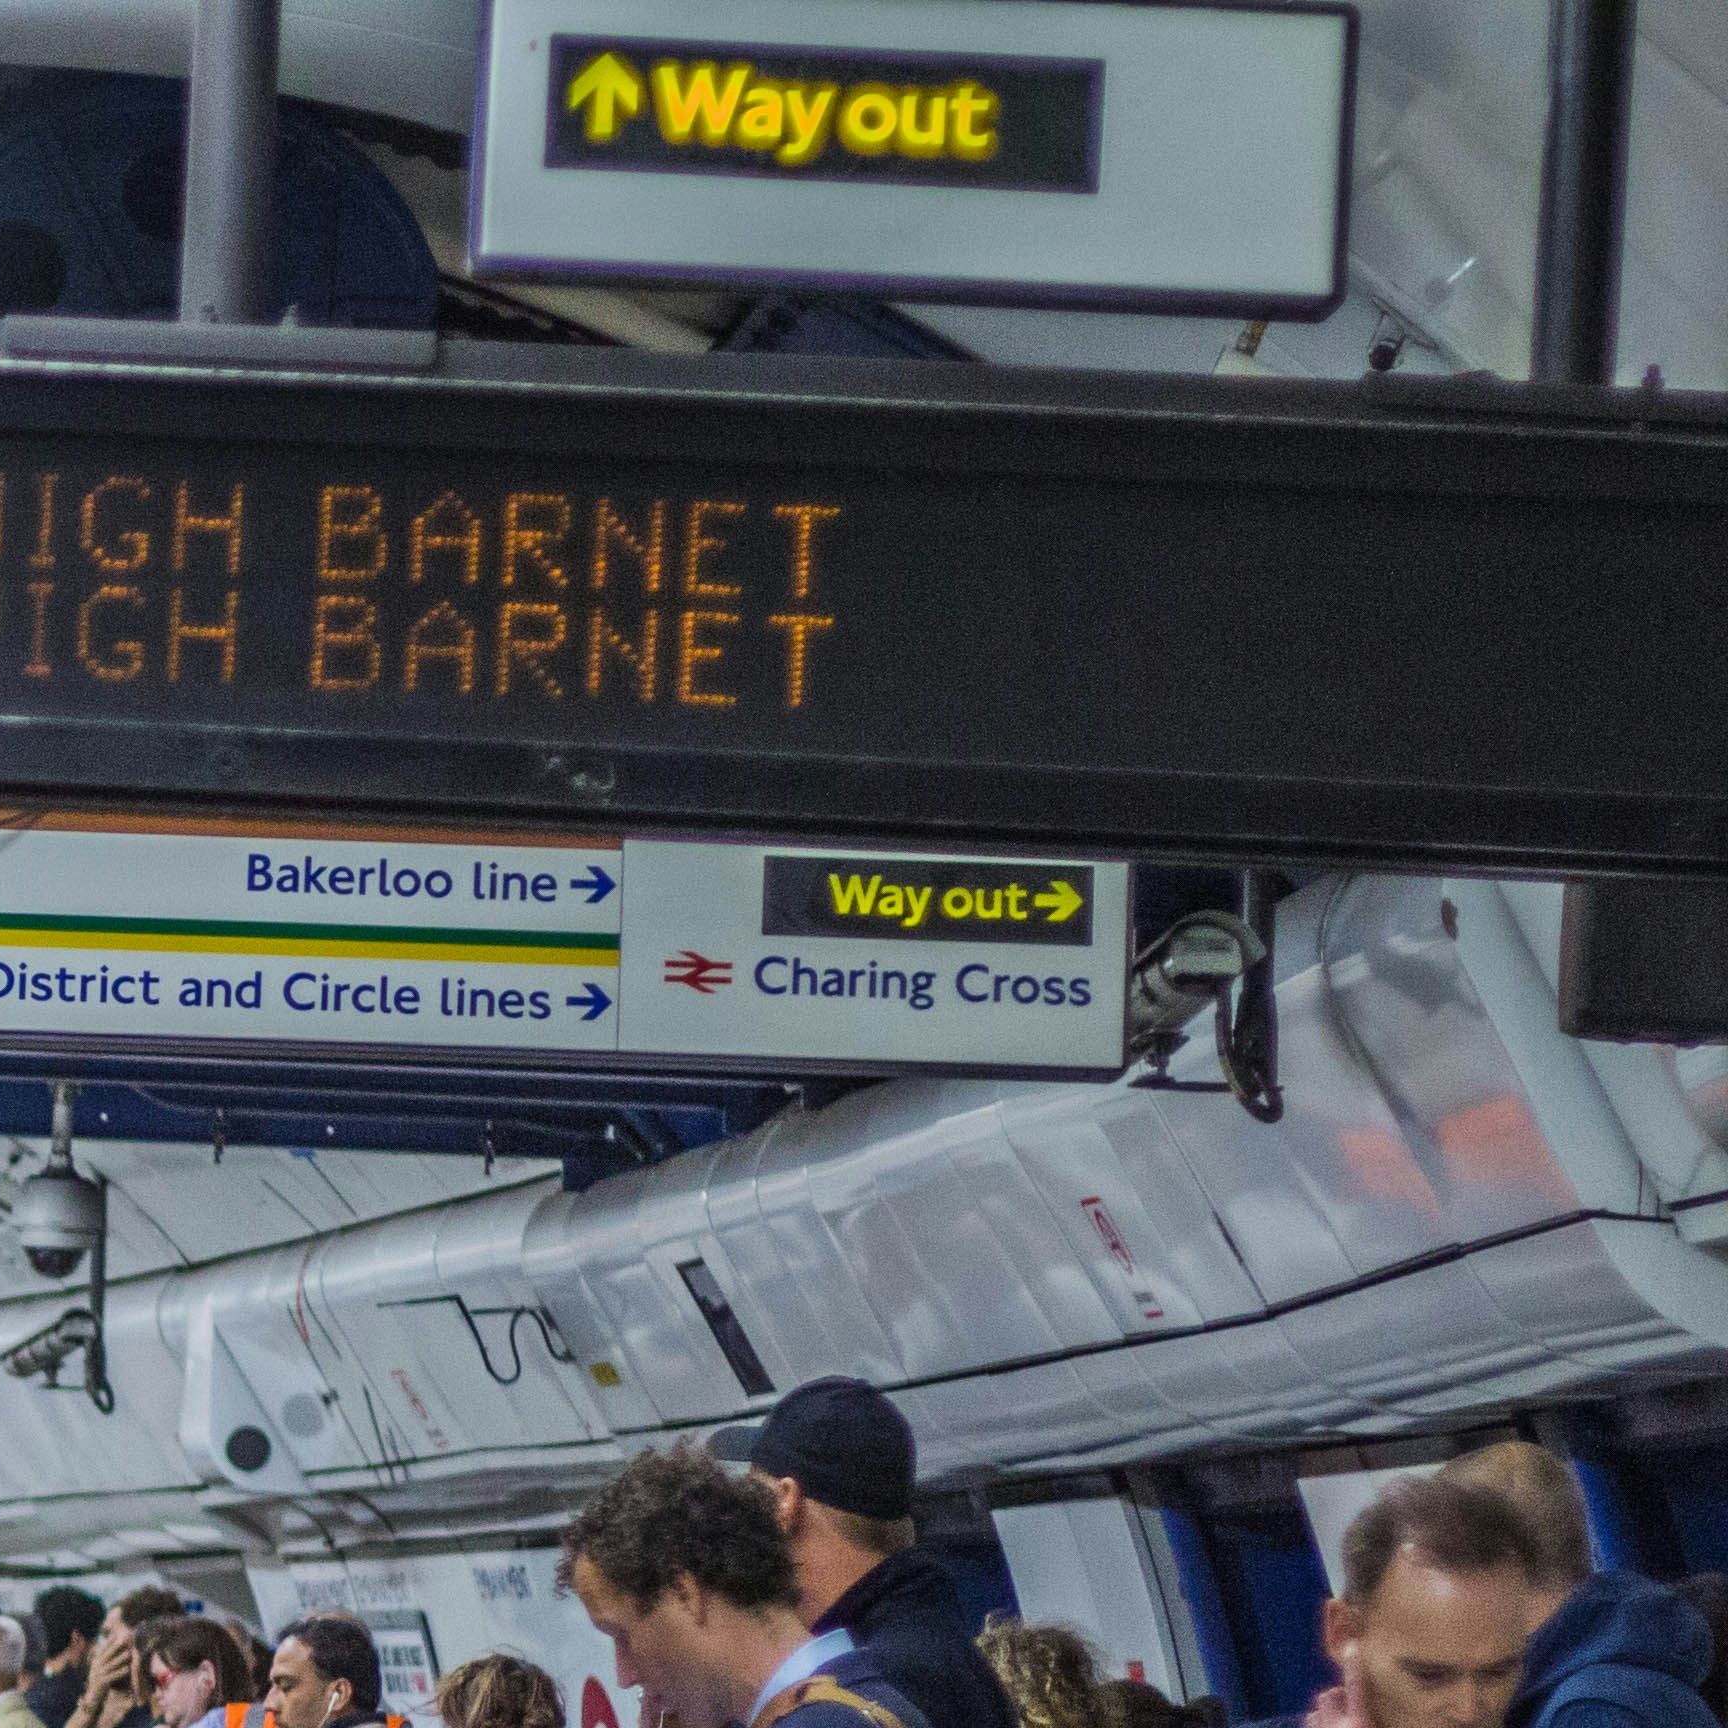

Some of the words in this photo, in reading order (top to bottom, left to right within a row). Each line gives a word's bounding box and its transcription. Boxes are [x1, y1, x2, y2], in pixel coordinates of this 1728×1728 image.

[652, 60, 836, 165] Way
[839, 78, 998, 158] out
[317, 485, 842, 600] BARNET
[312, 594, 835, 709] BARNET
[246, 854, 459, 901] Bakerloo
[471, 856, 558, 903] line
[828, 872, 929, 925] Way
[941, 881, 1028, 923] out
[175, 963, 263, 1010] and
[281, 968, 420, 1018] Circle
[438, 974, 552, 1023] lines
[754, 956, 936, 1012] Charing
[954, 963, 1091, 1010] Cross
